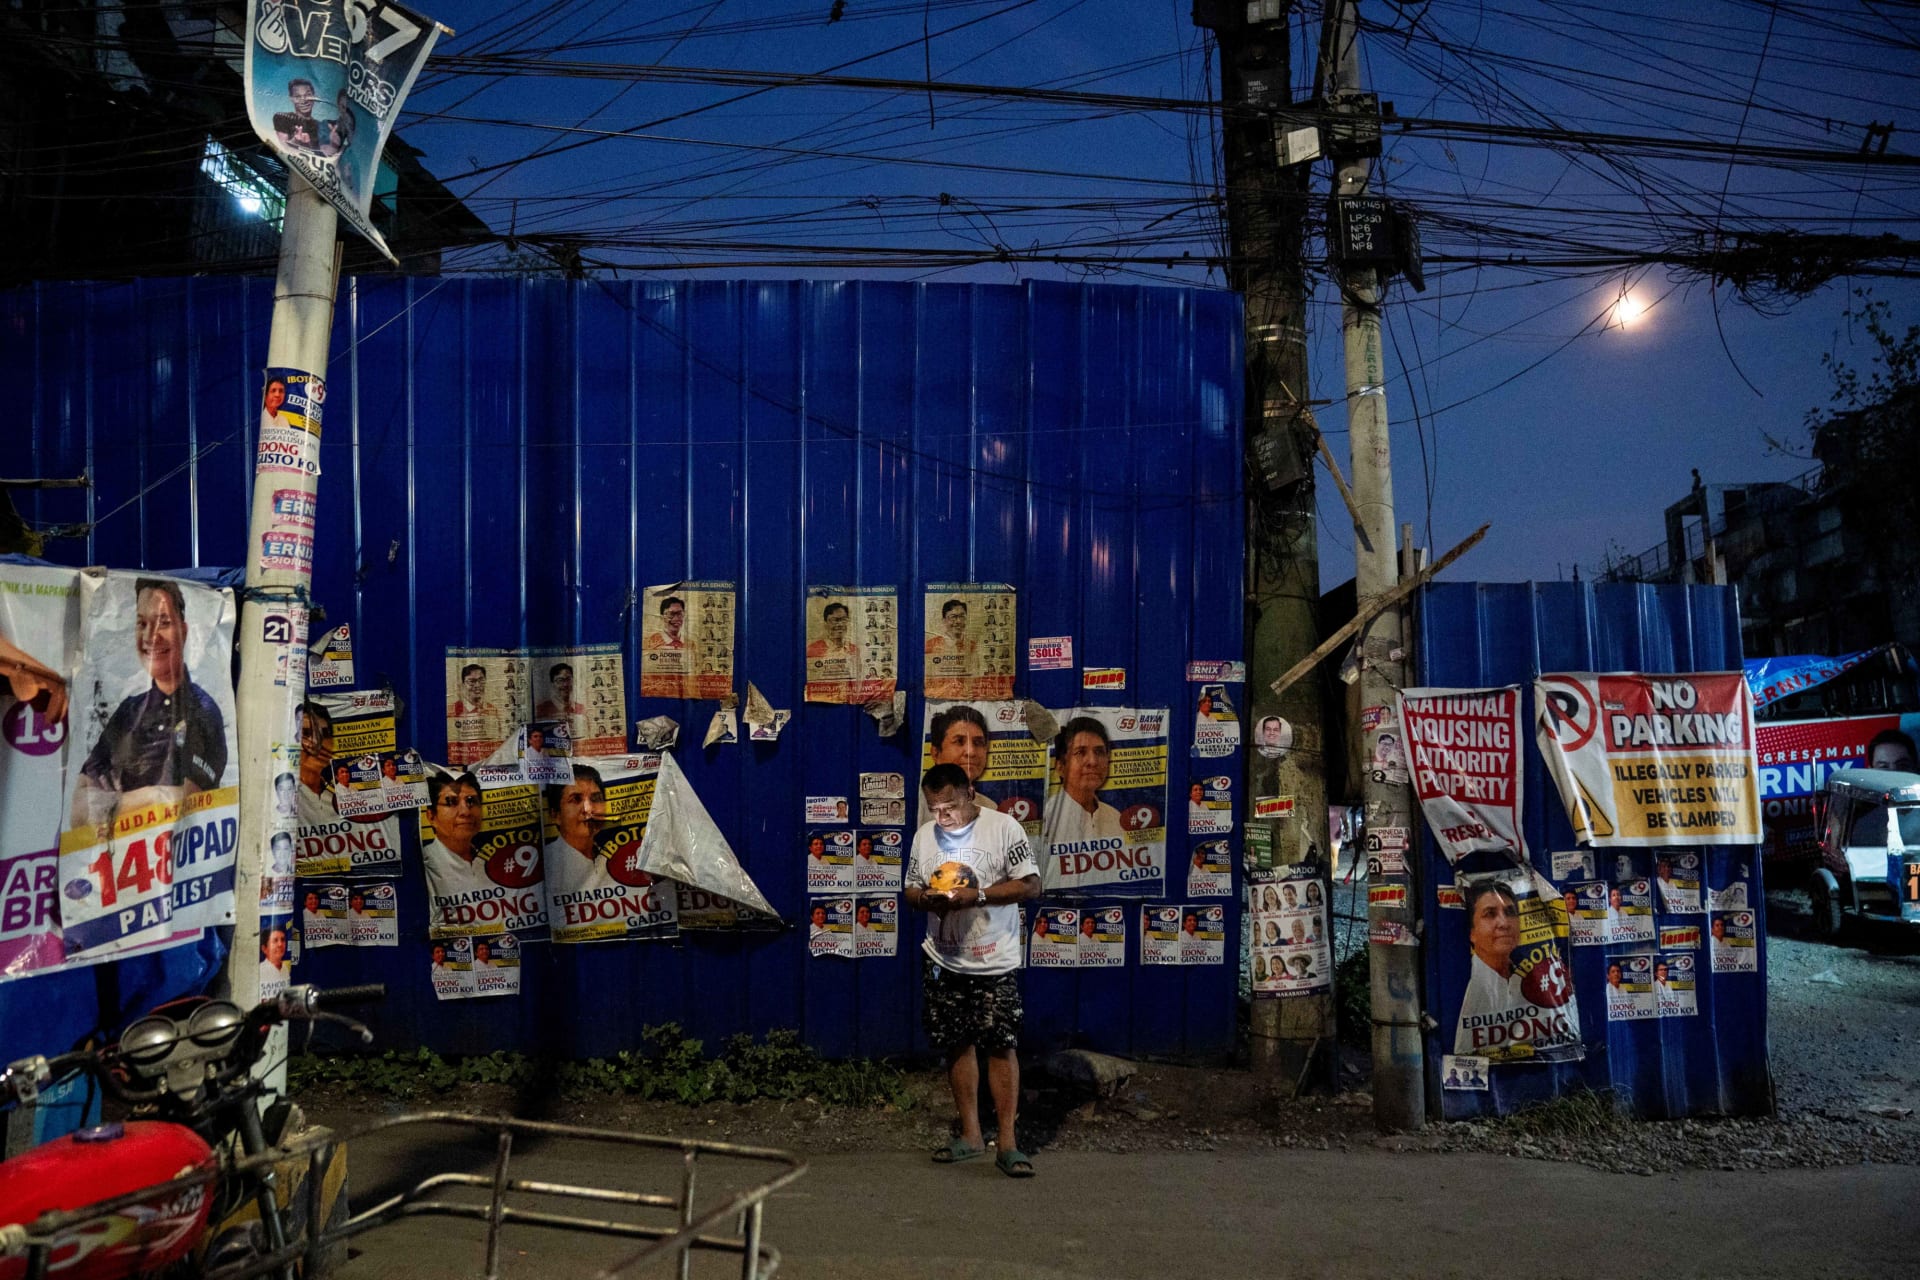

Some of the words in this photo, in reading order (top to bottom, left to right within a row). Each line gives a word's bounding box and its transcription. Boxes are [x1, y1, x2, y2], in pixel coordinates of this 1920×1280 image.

[265, 620, 290, 642] 21
[1036, 648, 1062, 658] SOLIS
[312, 670, 339, 679] EDONG
[312, 677, 337, 686] GUSTO
[339, 675, 354, 683] KO!
[1651, 679, 1698, 711] NO
[354, 697, 367, 707] 59
[1406, 693, 1511, 719] NATIONAL
[999, 709, 1016, 721] 59
[1139, 714, 1163, 723] BAYAN
[1119, 718, 1135, 730] 59
[1409, 716, 1511, 750] HOUSING
[1611, 711, 1743, 748] PARKING
[1197, 737, 1222, 745] GUSTO
[1225, 736, 1239, 744] KO!
[1763, 744, 1866, 763] GRESSMAN
[626, 759, 639, 769] 59
[528, 772, 555, 780] GUSTO
[1615, 763, 1691, 782] ILLEGALLY
[1695, 762, 1749, 780] PARKED
[481, 774, 508, 783] GUSTO
[508, 773, 524, 782] KO!
[1417, 769, 1509, 801] POPERTY
[387, 793, 414, 803] EDONG
[1632, 787, 1707, 806] VEHICLES
[1709, 786, 1740, 803] WILL
[340, 800, 368, 810] EDONG
[388, 800, 413, 809] GUSTO
[340, 807, 367, 817] GUSTO
[369, 803, 385, 812] KO!
[1007, 800, 1030, 821] #9
[1129, 807, 1153, 829] #9
[1188, 819, 1216, 827] EDONG
[1646, 812, 1668, 829] BE
[1670, 810, 1736, 828] CLAMPED
[1188, 826, 1215, 834] GUSTO
[1216, 825, 1231, 833] KO!
[296, 828, 386, 859] EDONG
[477, 828, 540, 862] IBOTO!
[1049, 838, 1122, 856] EDUARDO
[1368, 837, 1380, 850] 21
[351, 848, 396, 864] GADO
[1059, 846, 1152, 876] EDONG
[503, 845, 539, 878] #9
[88, 829, 174, 908] 148
[1369, 861, 1380, 873] 21
[808, 873, 838, 881] EDONG
[857, 873, 885, 881] EDONG
[1119, 865, 1161, 881] GADO
[808, 880, 836, 888] GUSTO
[837, 880, 853, 888] KO!
[857, 880, 883, 888] GUSTO
[885, 879, 900, 888] KO!
[1907, 876, 1920, 901] 1
[173, 876, 214, 908] LIST
[434, 886, 506, 907] EDUARDO
[553, 885, 627, 907] EDUARDO
[1190, 888, 1216, 896] GUSTO
[1218, 888, 1233, 896] KO!
[678, 890, 738, 911] EDO
[441, 892, 540, 926] EDONG
[564, 892, 661, 926] EDONG
[1685, 905, 1700, 913] KO!
[505, 911, 549, 929] GADO
[627, 909, 672, 928] GADO
[304, 927, 334, 935] EDONG
[351, 927, 379, 935] EDONG
[1611, 926, 1637, 934] EDONG
[305, 934, 333, 942] GUSTO
[351, 933, 377, 942] GUSTO
[1612, 932, 1637, 941] GUSTO
[1639, 930, 1653, 939] KO!
[810, 941, 839, 949] EDONG
[856, 941, 884, 950] EDONG
[856, 948, 882, 956] GUSTO
[1032, 952, 1060, 960] EDONG
[1080, 951, 1107, 959] EDONG
[1181, 949, 1207, 957] EDONG
[1032, 959, 1058, 967] GUSTO
[1060, 959, 1075, 967] KO!
[1080, 958, 1105, 966] GUSTO
[1106, 957, 1122, 966] KO!
[1181, 955, 1206, 964] GUSTO
[1207, 955, 1222, 963] KO!
[1713, 956, 1738, 965] EDONG
[1713, 963, 1737, 972] GUSTO
[1738, 962, 1753, 970] KO!
[478, 976, 506, 985] EDONG
[1539, 959, 1567, 996] #9
[433, 979, 460, 988] EDONG
[478, 983, 505, 992] GUSTO
[1609, 1002, 1636, 1011] EDONG
[1680, 1006, 1695, 1015] KO!
[1462, 1005, 1539, 1030] EDUARDO
[1610, 1009, 1635, 1018] GUSTO
[1637, 1009, 1652, 1017] KO!
[1472, 1012, 1570, 1048] EDONG
[1533, 1032, 1577, 1049] GADO
